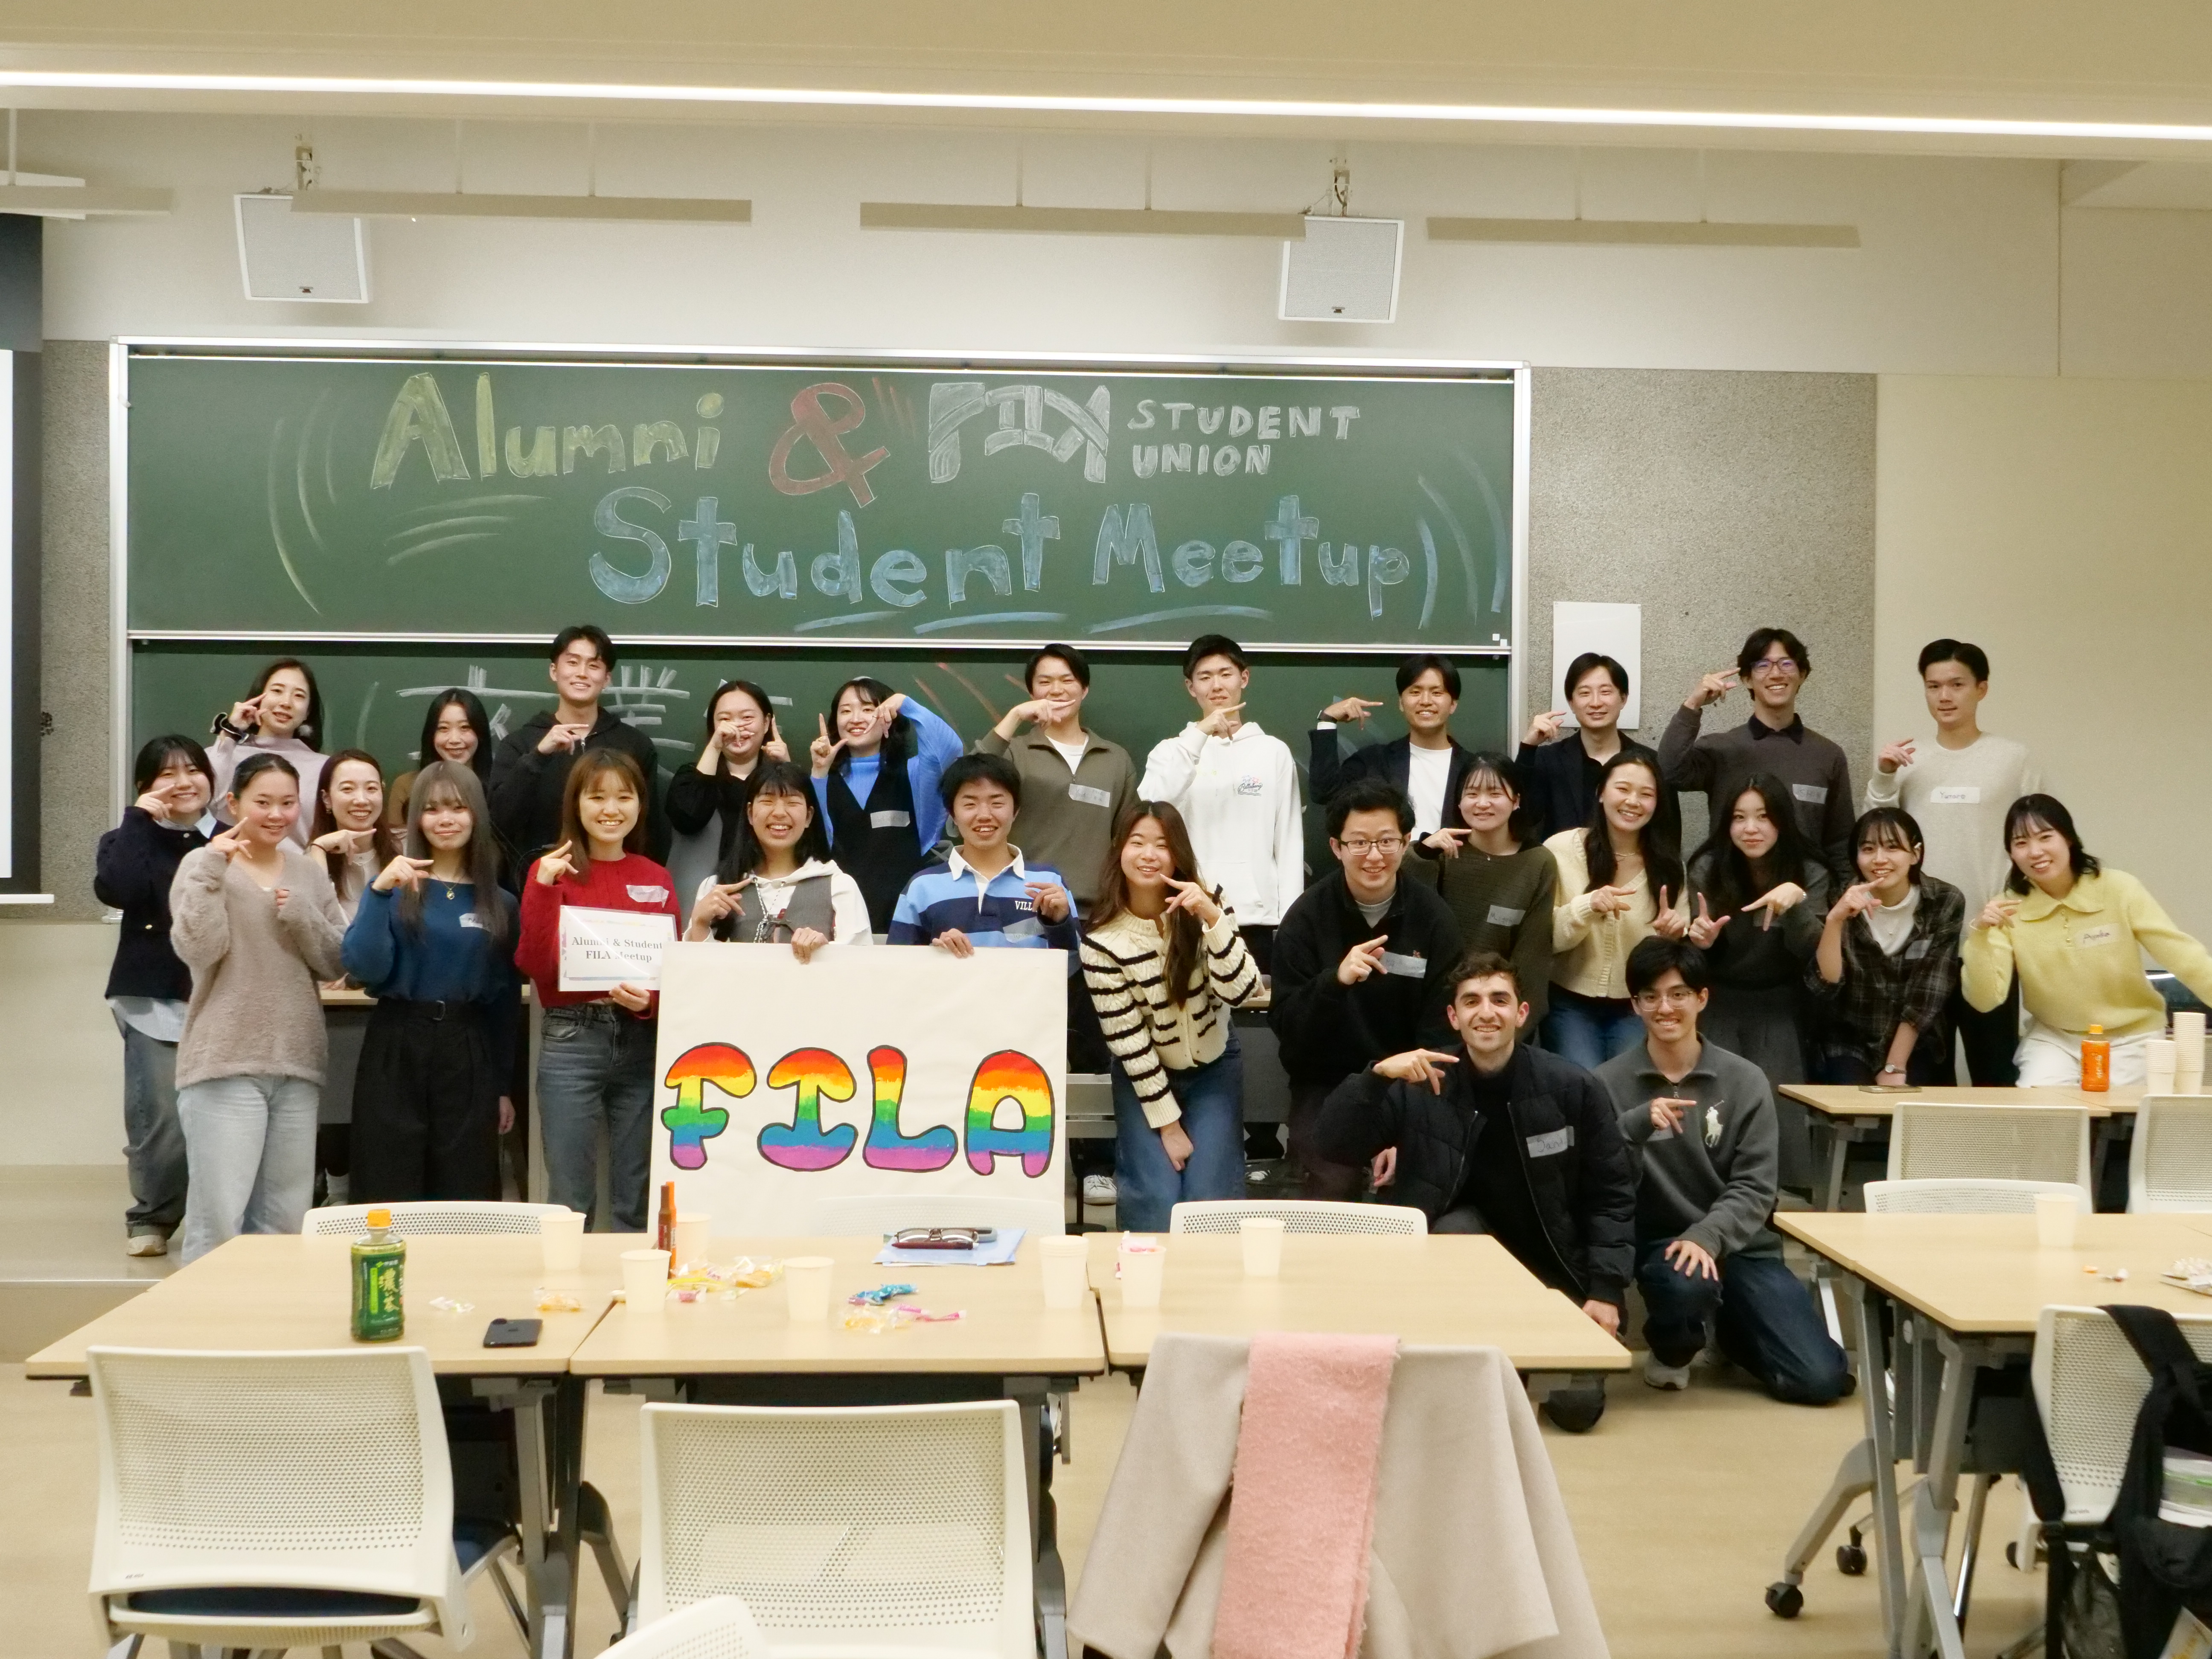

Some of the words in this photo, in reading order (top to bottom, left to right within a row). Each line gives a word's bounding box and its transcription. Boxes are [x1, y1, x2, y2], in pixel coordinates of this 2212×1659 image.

[1127, 399, 1360, 440] STUDENT
[370, 372, 725, 489] Alumni
[769, 382, 891, 508] &
[1132, 444, 1272, 479] UNION
[588, 486, 1061, 609] Student
[1091, 495, 1410, 620] Meetup
[1237, 781, 1263, 792] Billabong
[1014, 900, 1038, 912] VILL
[586, 950, 611, 960] FILA
[613, 938, 621, 947] &
[624, 939, 662, 949] Student
[660, 1041, 1055, 1179] FILA
